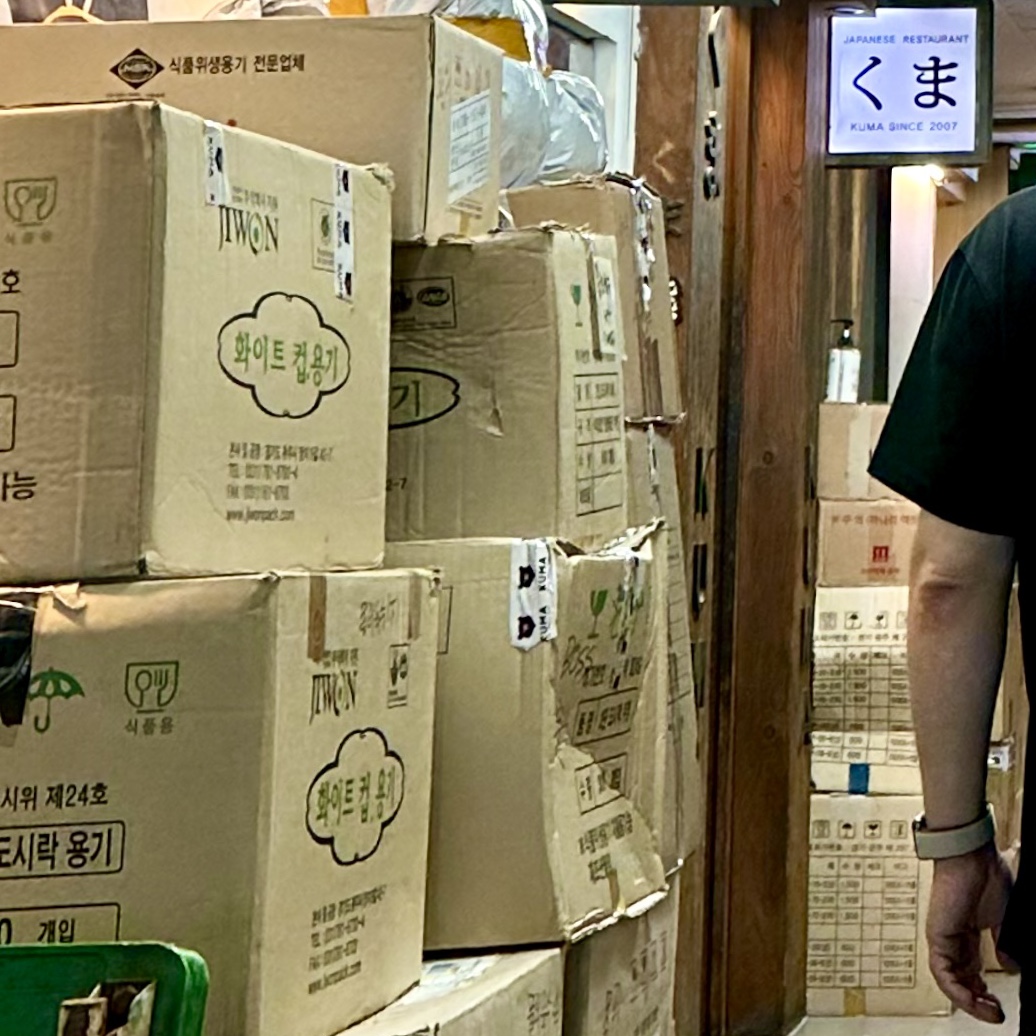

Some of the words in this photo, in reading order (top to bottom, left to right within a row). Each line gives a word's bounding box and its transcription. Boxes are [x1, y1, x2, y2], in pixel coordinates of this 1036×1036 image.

[843, 35, 896, 45] JAPANESE
[902, 34, 970, 45] RESTAURANT
[168, 55, 248, 76] 식품위생용기
[253, 53, 306, 74] 전문업체
[852, 55, 959, 112] くま
[850, 122, 884, 132] KUMA
[888, 121, 924, 132] SINCE
[929, 121, 958, 132] 2007
[218, 204, 280, 257] JIWON
[538, 556, 547, 592] KUMA
[45, 782, 109, 810] 제24호
[66, 827, 113, 870] 용기
